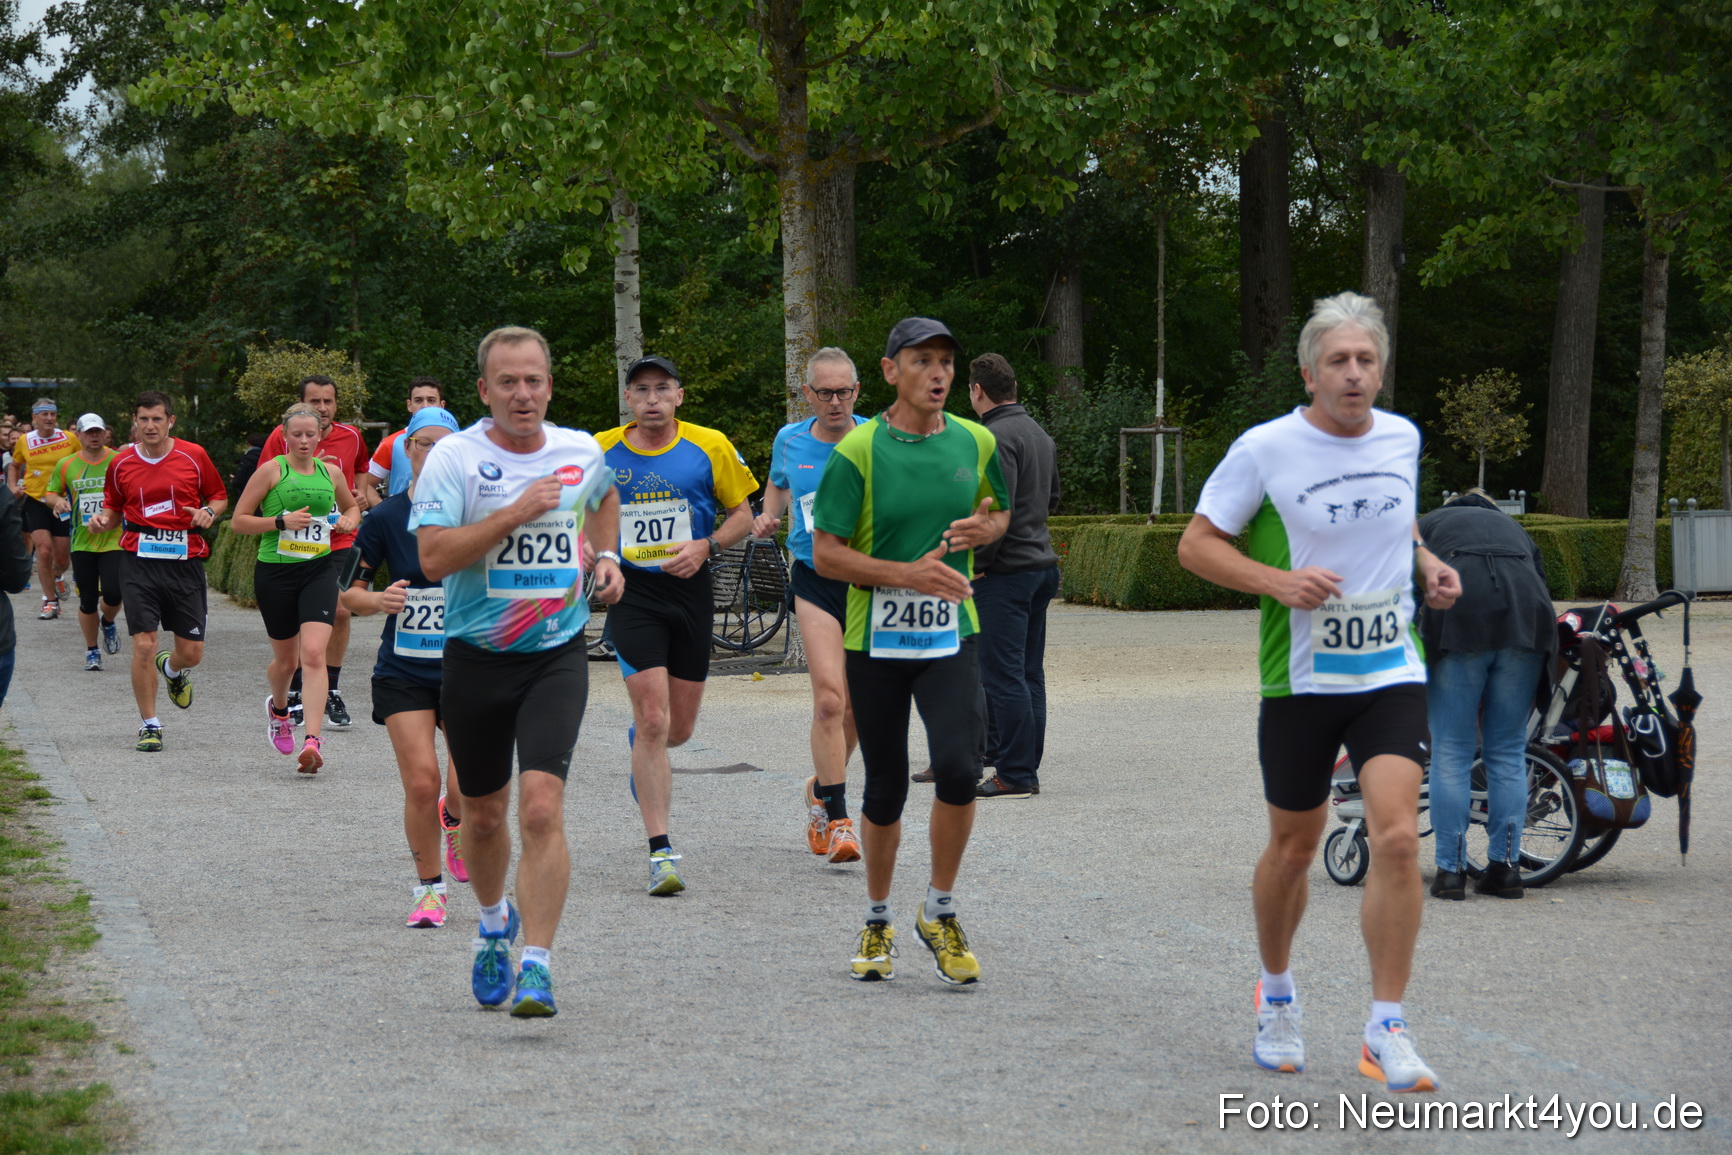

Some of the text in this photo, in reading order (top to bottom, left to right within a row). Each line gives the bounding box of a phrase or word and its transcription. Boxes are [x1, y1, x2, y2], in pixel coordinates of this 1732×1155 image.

[479, 485, 507, 493] PARTL
[643, 507, 676, 516] Neumarkt
[521, 520, 564, 529] Neumarkt
[634, 517, 676, 543] 207
[150, 544, 176, 553] Thomas
[289, 543, 320, 553] Christina
[497, 533, 572, 565] 2629
[514, 573, 556, 586] Patrick
[1316, 598, 1391, 612] ARTL Neumarkt
[882, 600, 950, 628] 2468
[1323, 611, 1398, 650] 3043
[898, 634, 932, 648] Albert
